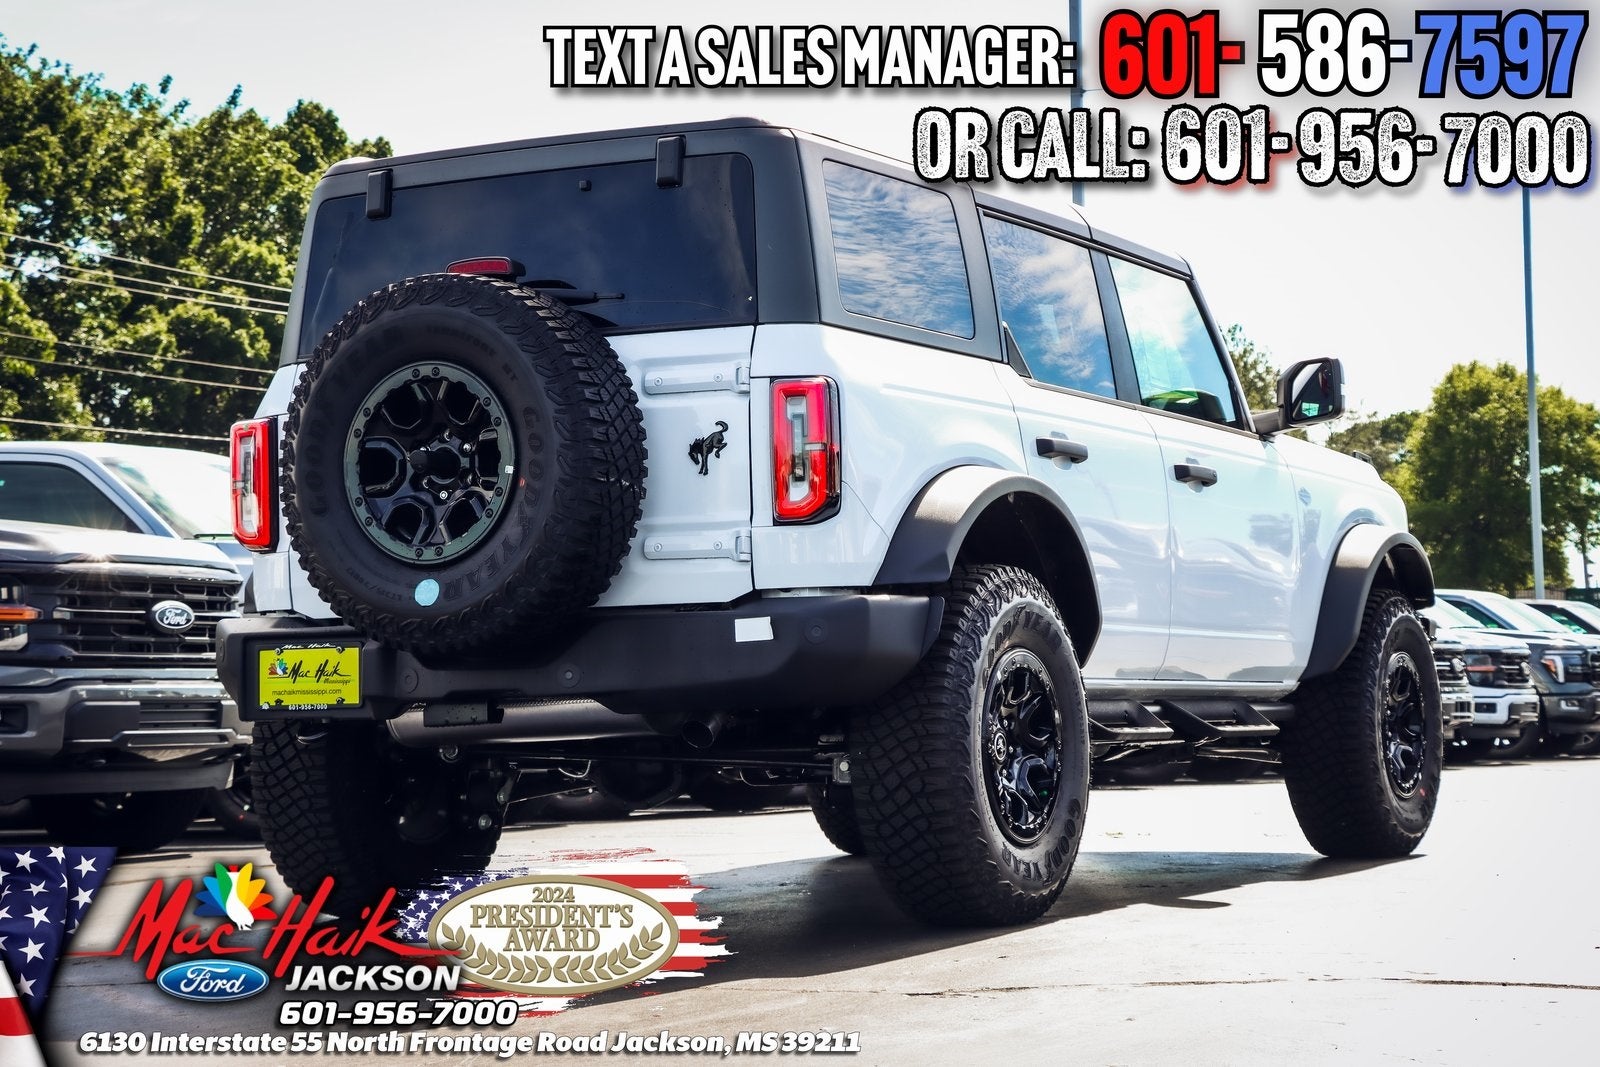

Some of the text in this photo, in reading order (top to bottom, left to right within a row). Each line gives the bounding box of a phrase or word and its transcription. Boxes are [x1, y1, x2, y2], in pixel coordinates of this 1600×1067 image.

[162, 609, 187, 625] Ford
[287, 659, 351, 684] Mac Haik
[272, 688, 342, 696] machaikmississippi.com
[288, 703, 328, 711] 601-956-7000
